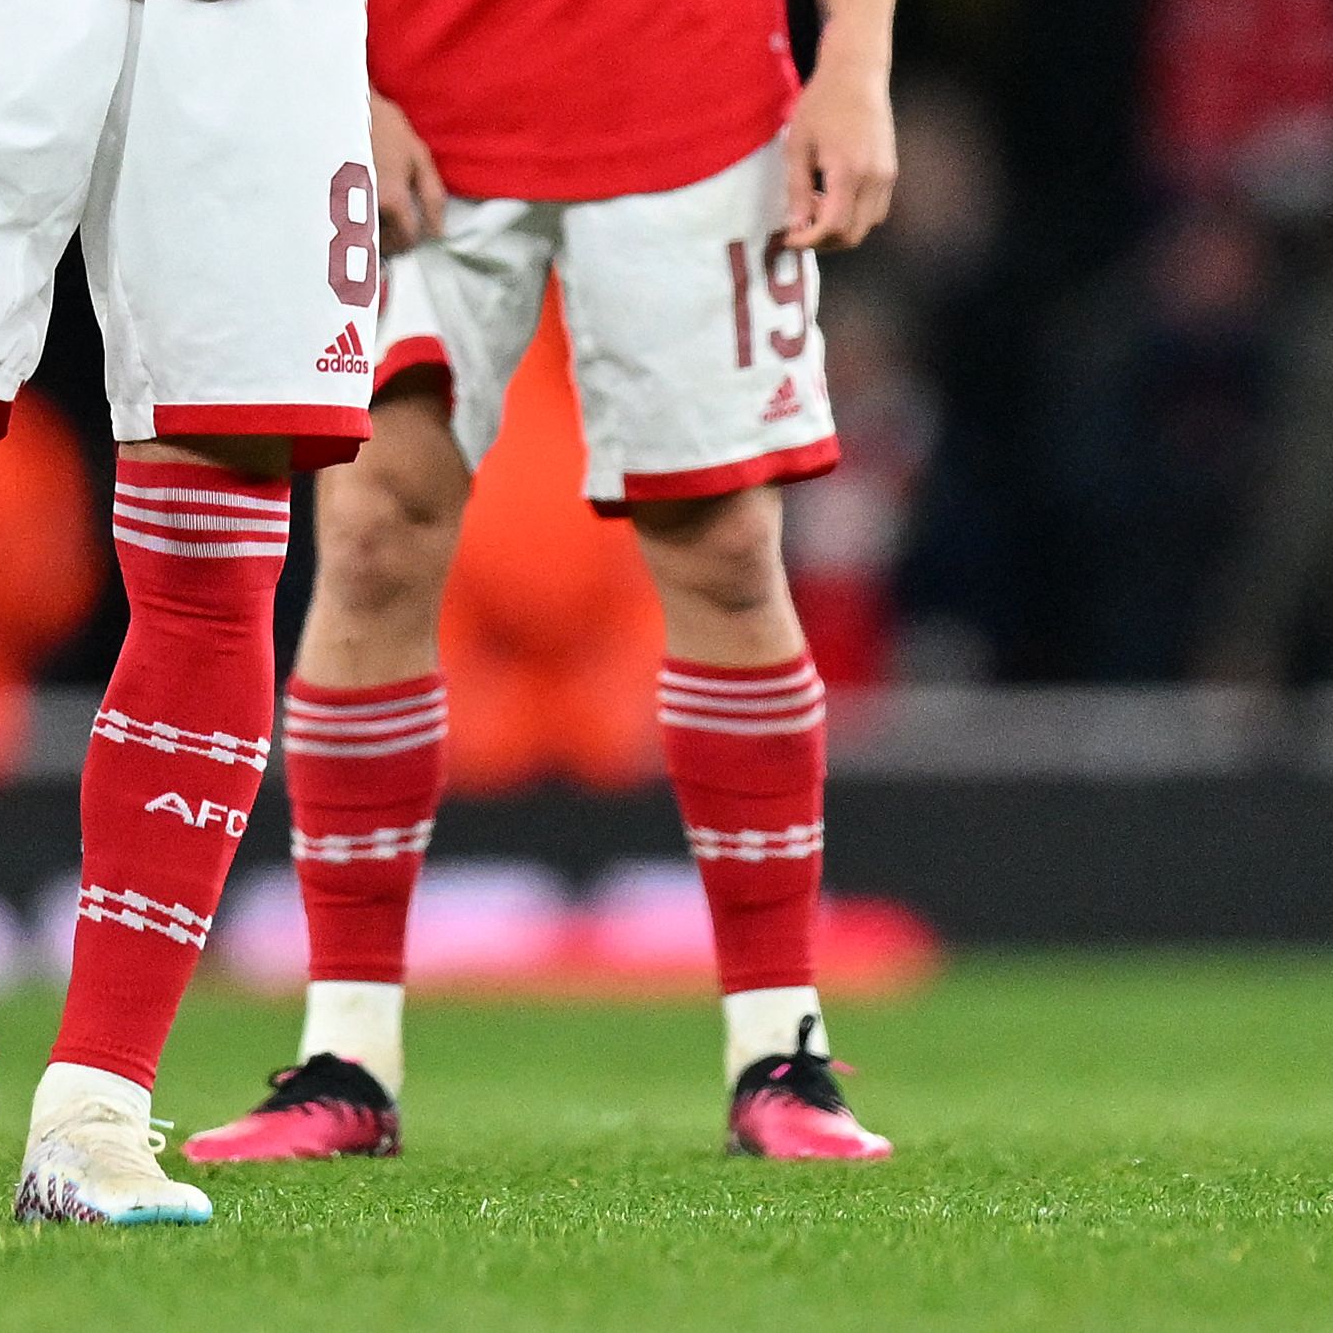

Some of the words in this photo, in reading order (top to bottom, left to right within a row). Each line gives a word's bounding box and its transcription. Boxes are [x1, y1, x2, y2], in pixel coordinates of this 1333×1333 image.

[328, 161, 376, 307] 8
[729, 228, 809, 369] 19
[316, 353, 368, 374] adidas
[144, 792, 248, 838] AFC
